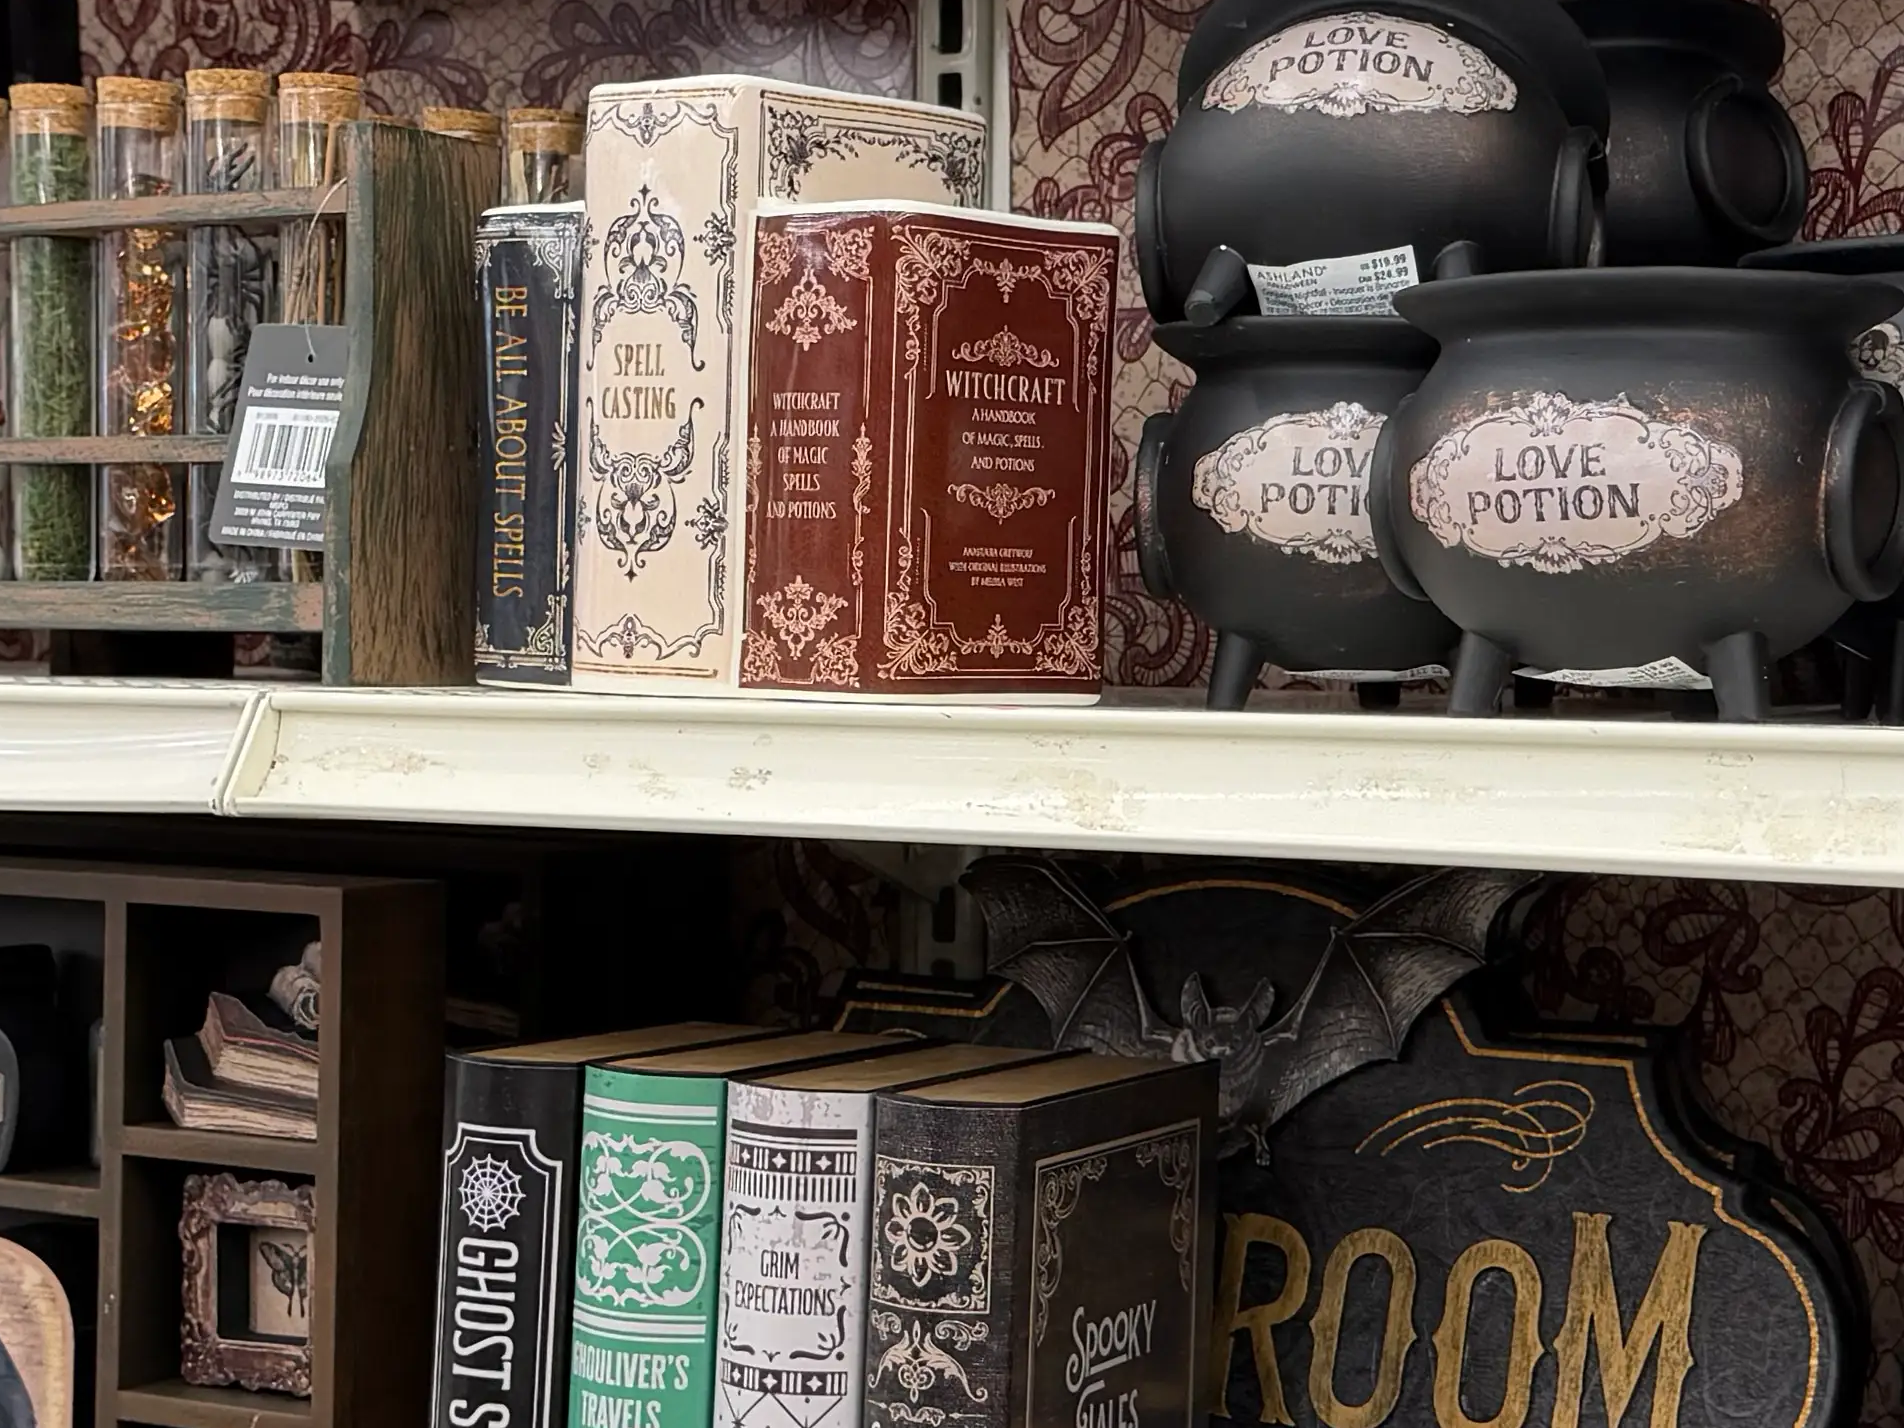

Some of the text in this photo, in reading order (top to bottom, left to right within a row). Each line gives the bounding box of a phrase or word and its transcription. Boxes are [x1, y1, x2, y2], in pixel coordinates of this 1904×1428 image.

[1303, 26, 1412, 49] LOVE
[1269, 48, 1435, 83] POTION
[614, 343, 665, 377] SPELL
[602, 385, 676, 420] CASTING
[773, 392, 840, 410] WITCHCRAFT
[946, 370, 1066, 405] WITCHCRAFT
[770, 419, 840, 437] A HANDBOOK
[980, 409, 1036, 425] HANDBOOK
[492, 286, 528, 598] BE ALL ABOUT SPELLS
[777, 446, 829, 464] OF MAGIC
[962, 431, 976, 445] OF
[970, 455, 1035, 472] AND POTIONS
[1291, 444, 1372, 479] LOV
[1495, 442, 1607, 481] LOVE
[783, 473, 821, 491] SPELLS
[766, 501, 837, 519] AND POTIONS
[1260, 482, 1372, 517] POTI
[1467, 482, 1641, 525] POTION
[760, 1249, 800, 1280] GRIM
[452, 1236, 520, 1392] GHOST
[735, 1280, 836, 1316] EXPECTATIONS
